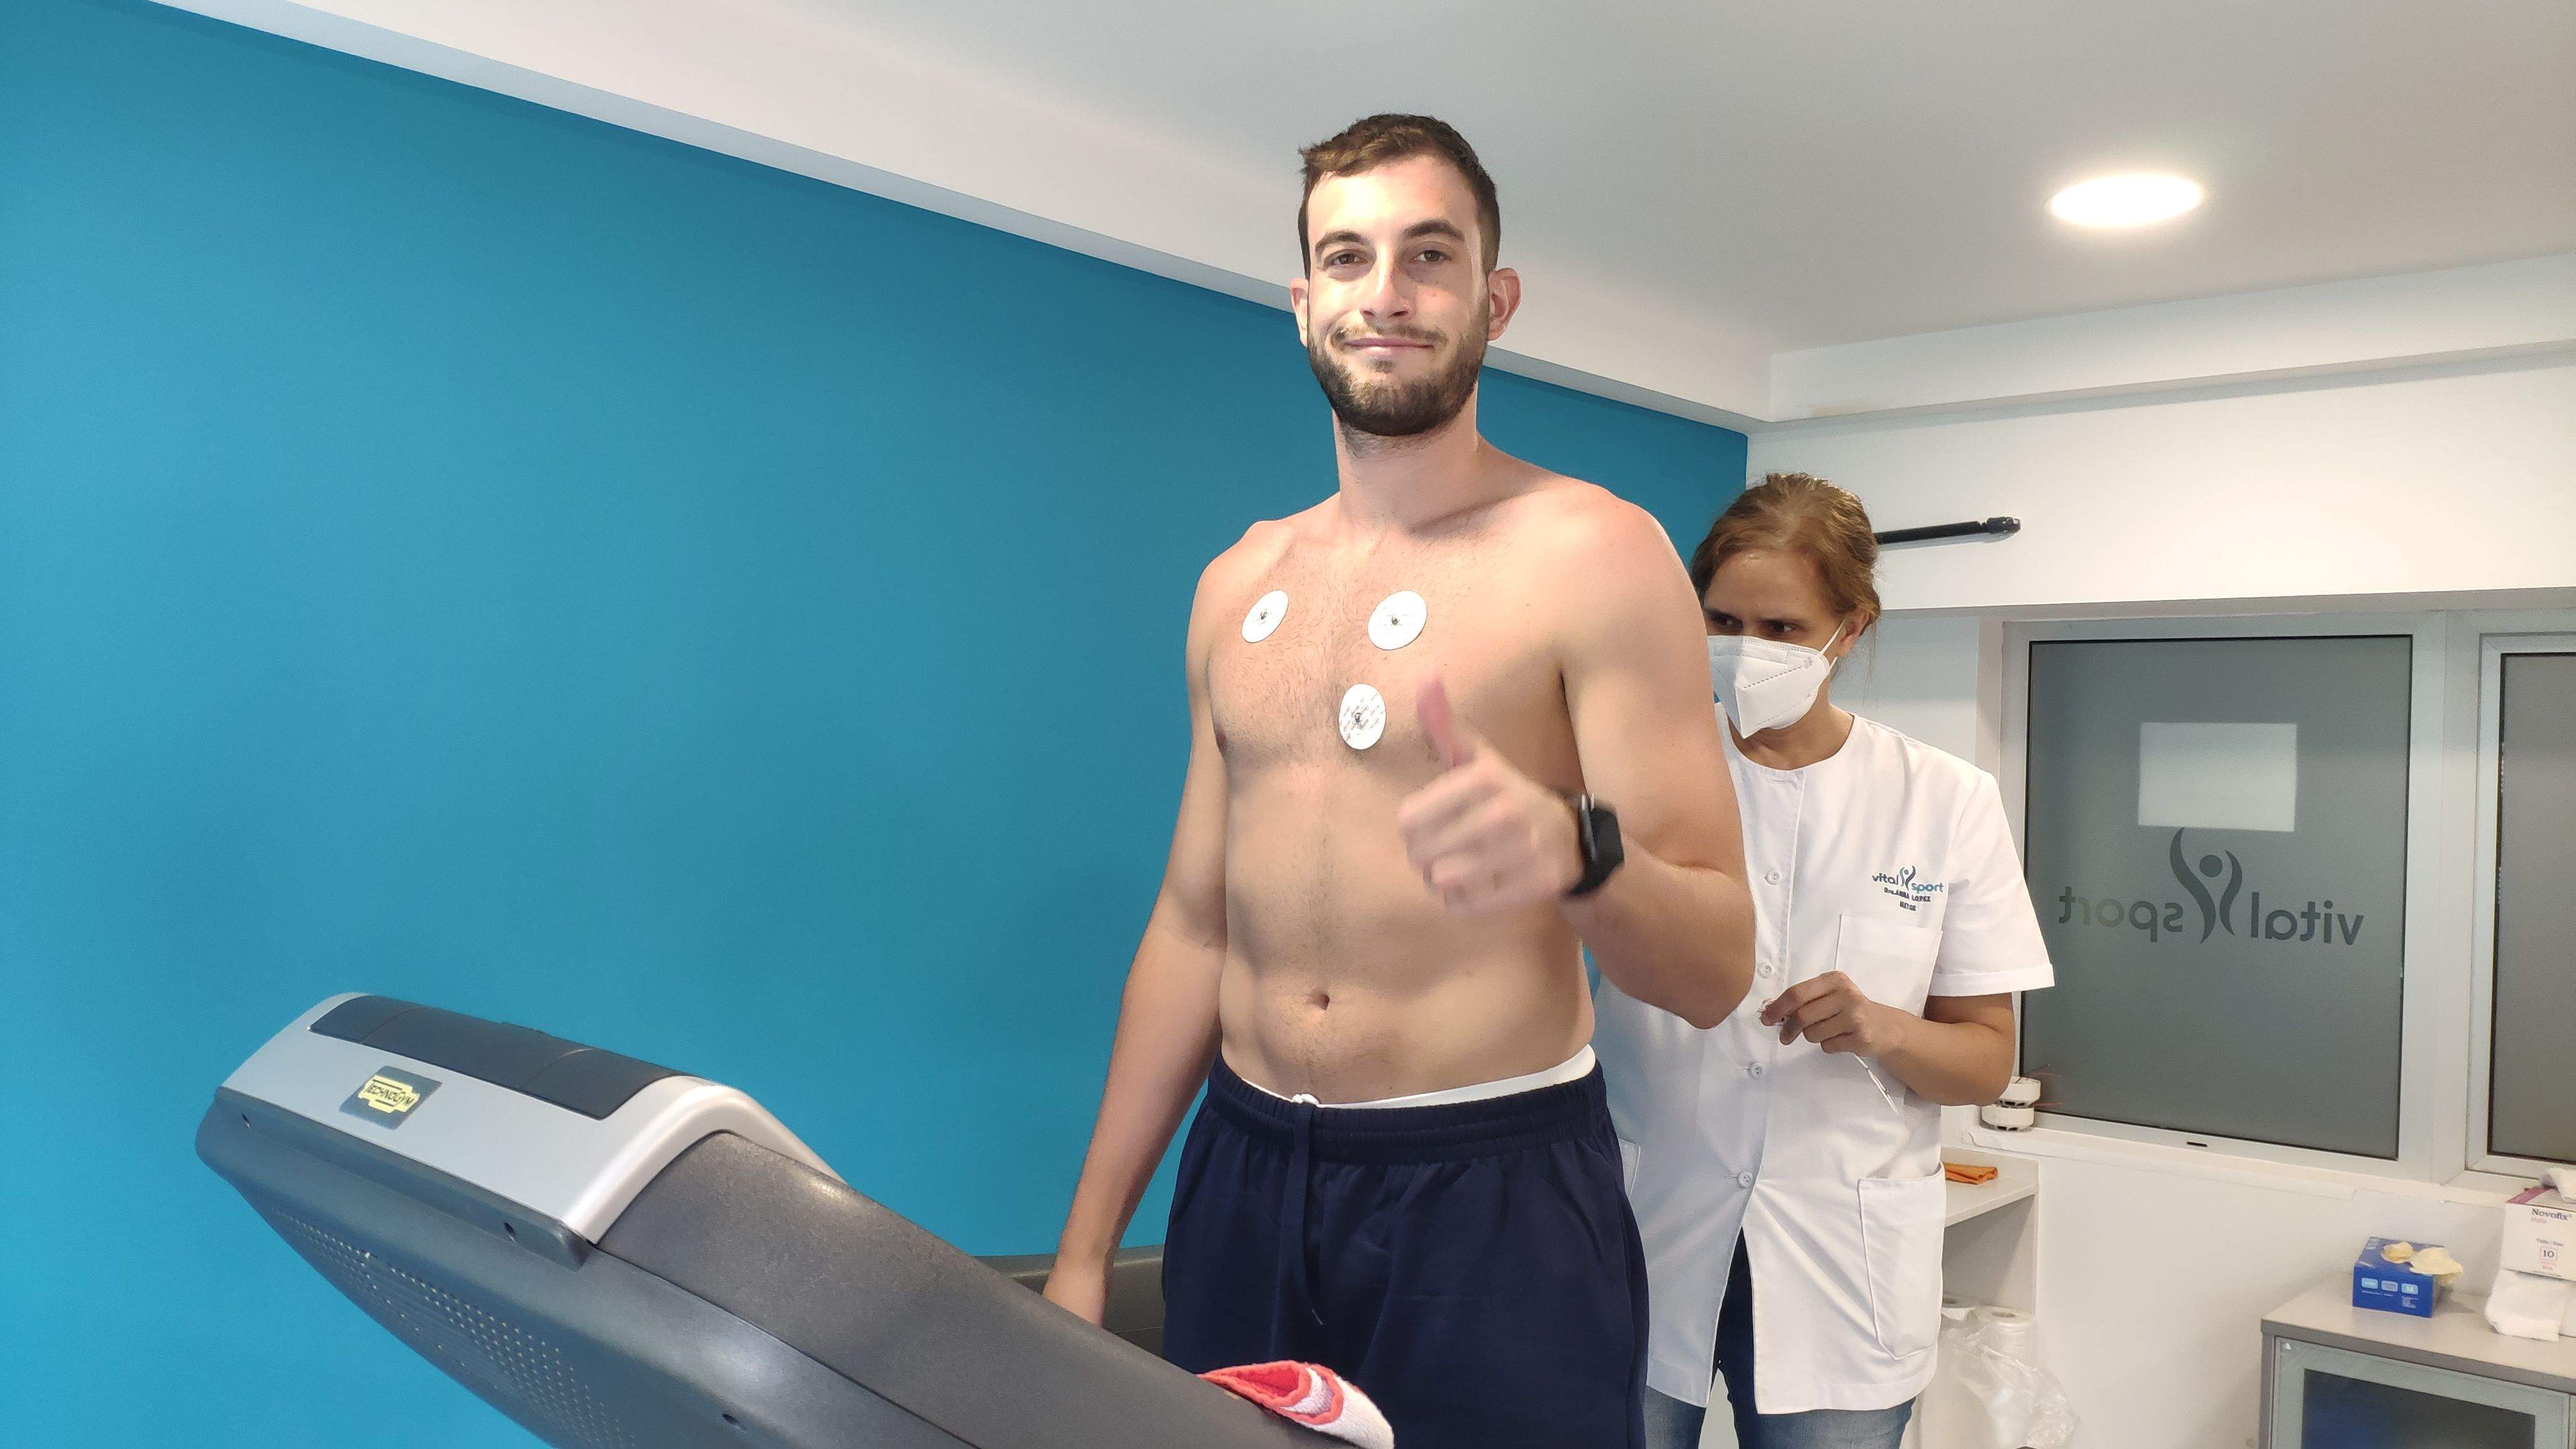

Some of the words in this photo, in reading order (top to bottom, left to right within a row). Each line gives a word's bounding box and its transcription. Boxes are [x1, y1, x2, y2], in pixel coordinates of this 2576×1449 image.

[1871, 873, 1899, 885] vital
[1911, 882, 1944, 894] sport
[2543, 1250, 2555, 1258] 10
